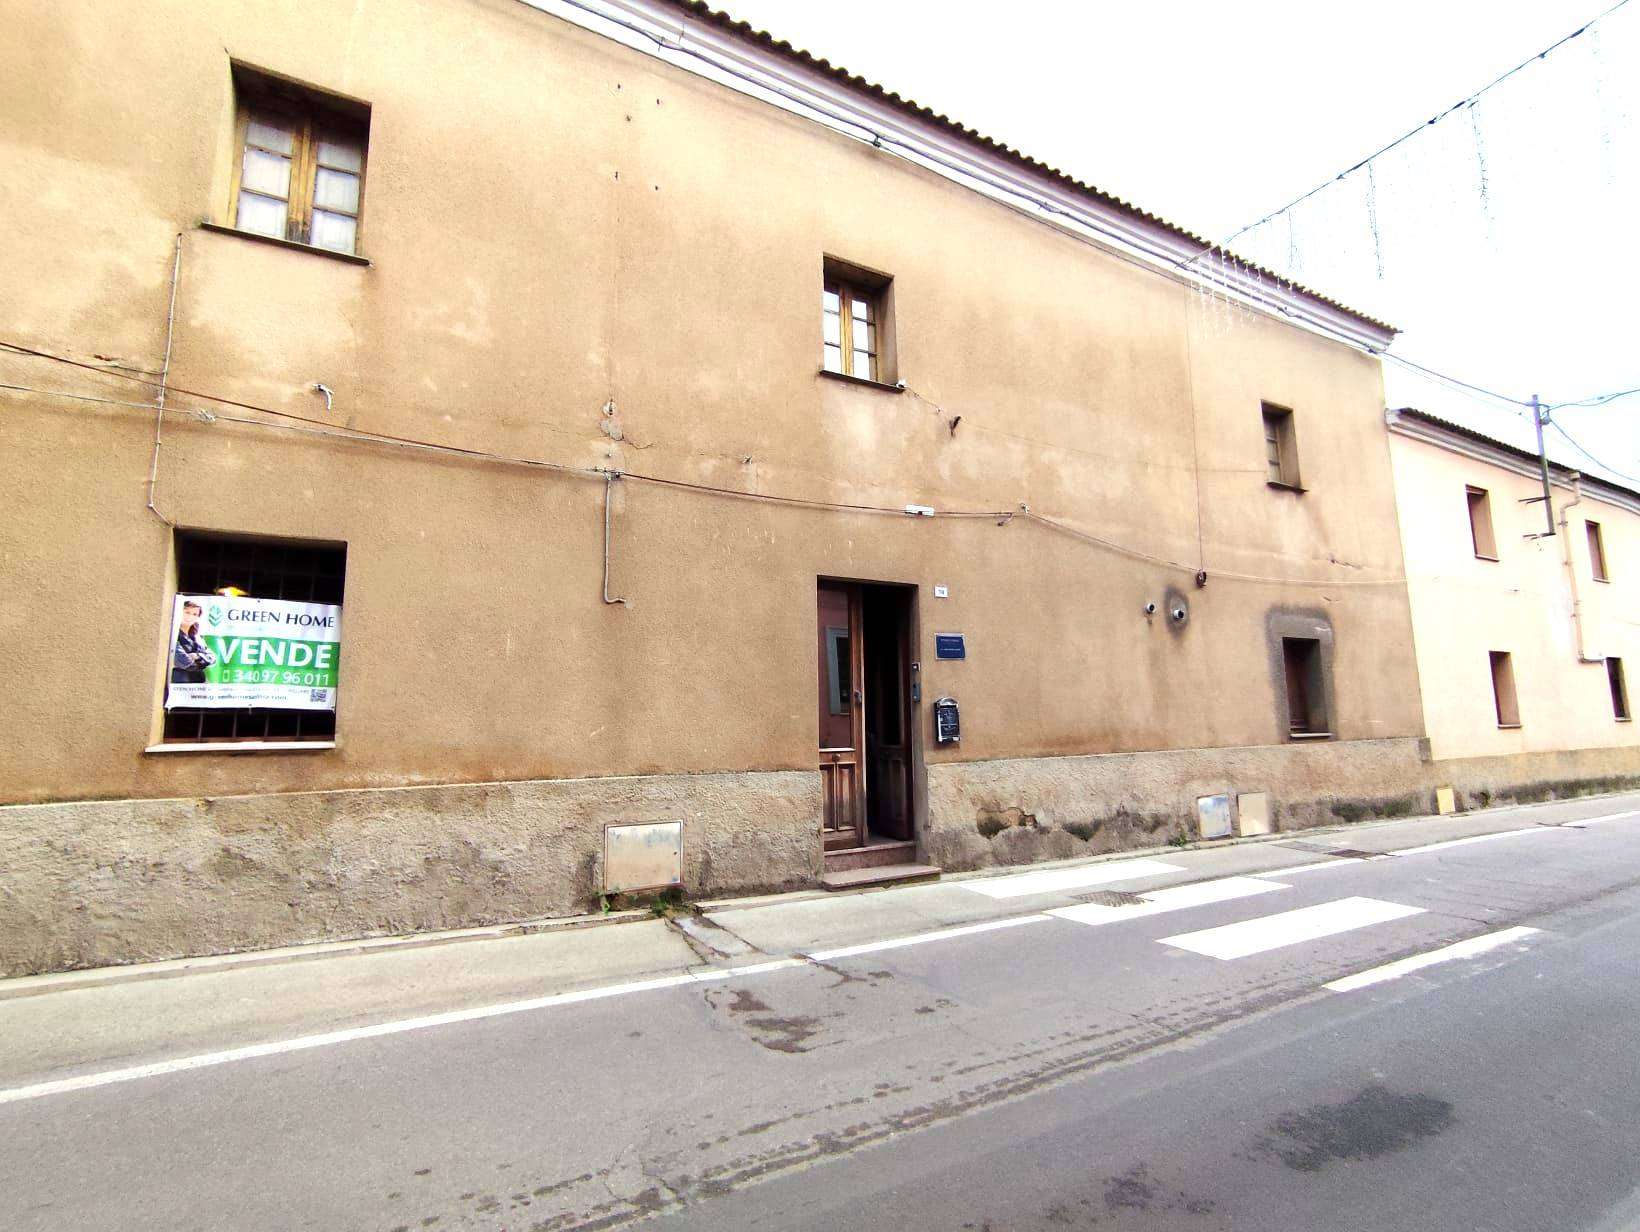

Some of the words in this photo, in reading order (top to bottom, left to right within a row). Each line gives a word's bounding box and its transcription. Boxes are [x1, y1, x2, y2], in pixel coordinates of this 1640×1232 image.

[227, 608, 281, 623] GREEN
[285, 613, 335, 628] HOME
[217, 638, 330, 669] VENDE
[282, 670, 301, 684] 96
[303, 673, 329, 686] 011
